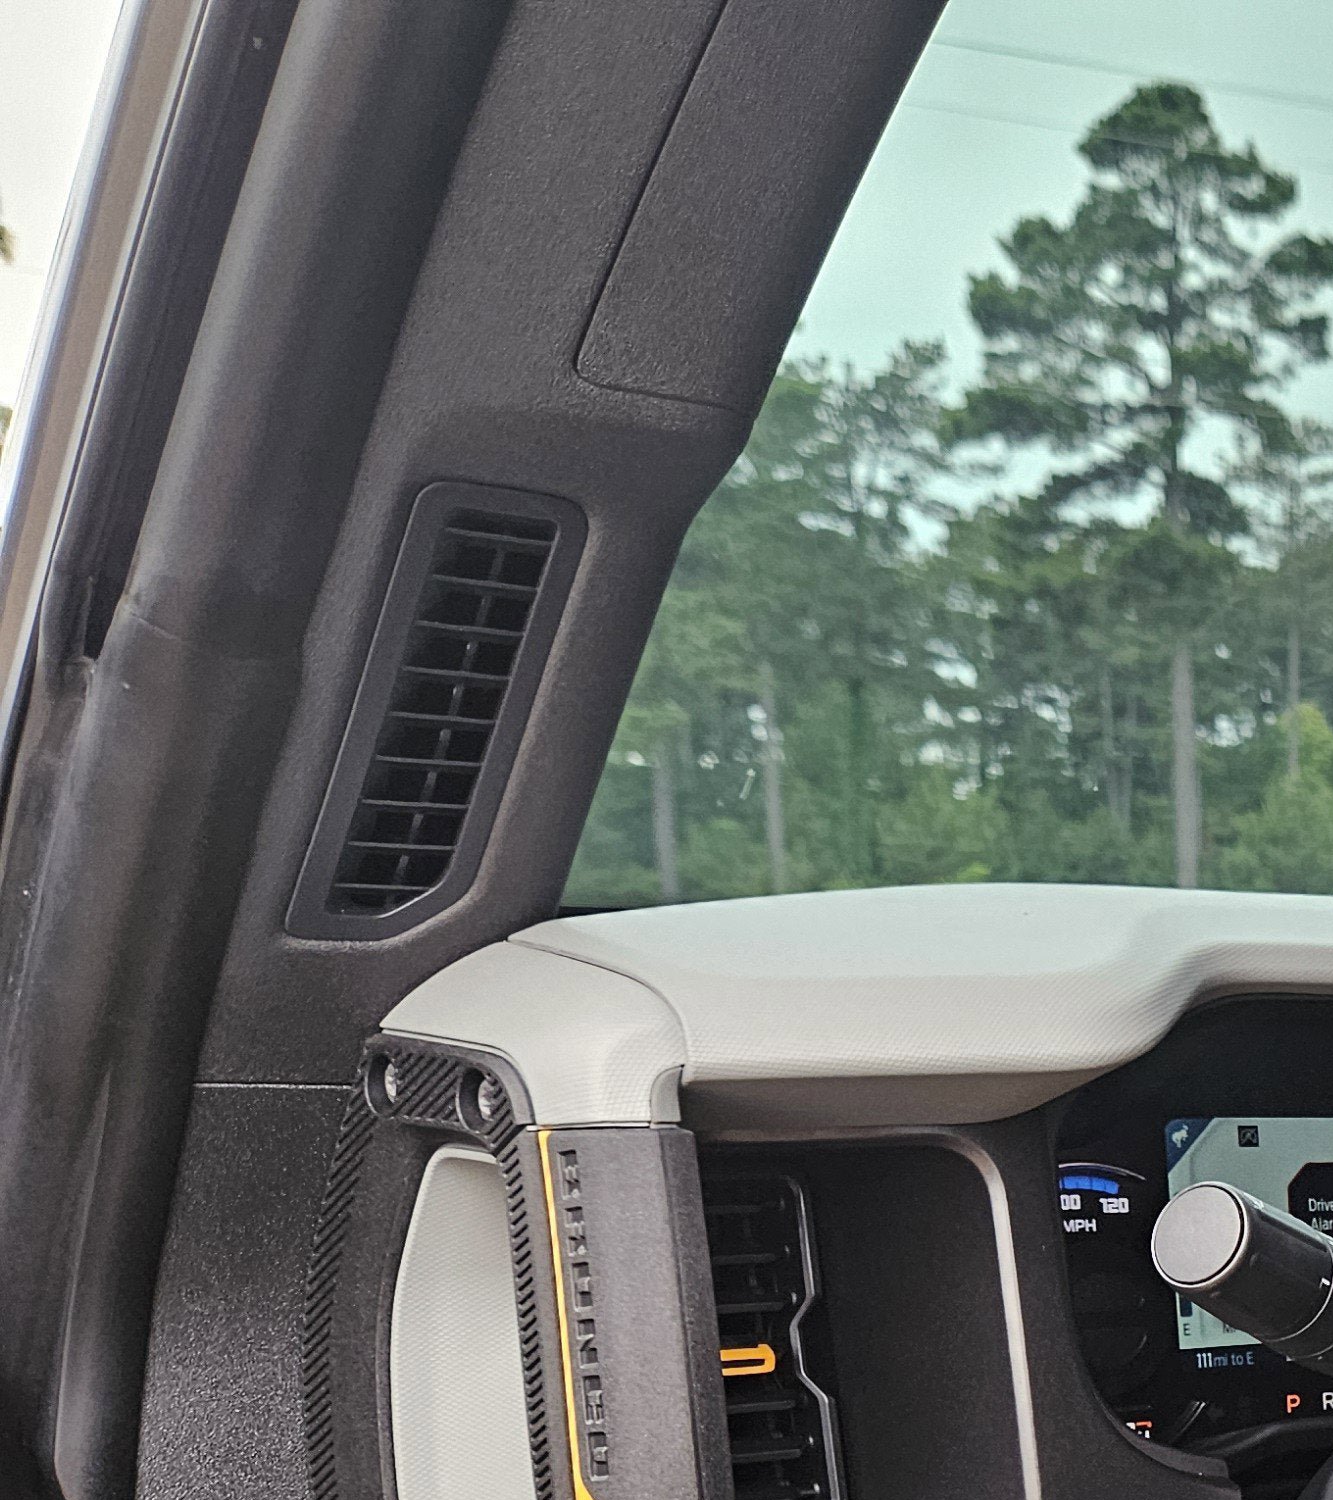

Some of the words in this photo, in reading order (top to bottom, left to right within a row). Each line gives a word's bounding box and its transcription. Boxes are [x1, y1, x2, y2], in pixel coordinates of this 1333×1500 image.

[1060, 1194, 1081, 1210] 00
[1099, 1197, 1130, 1213] 120
[1063, 1218, 1097, 1232] MPH
[1311, 1217, 1333, 1231] Ajar
[1231, 1352, 1243, 1366] to
[1246, 1351, 1255, 1365] E
[1286, 1394, 1301, 1413] P
